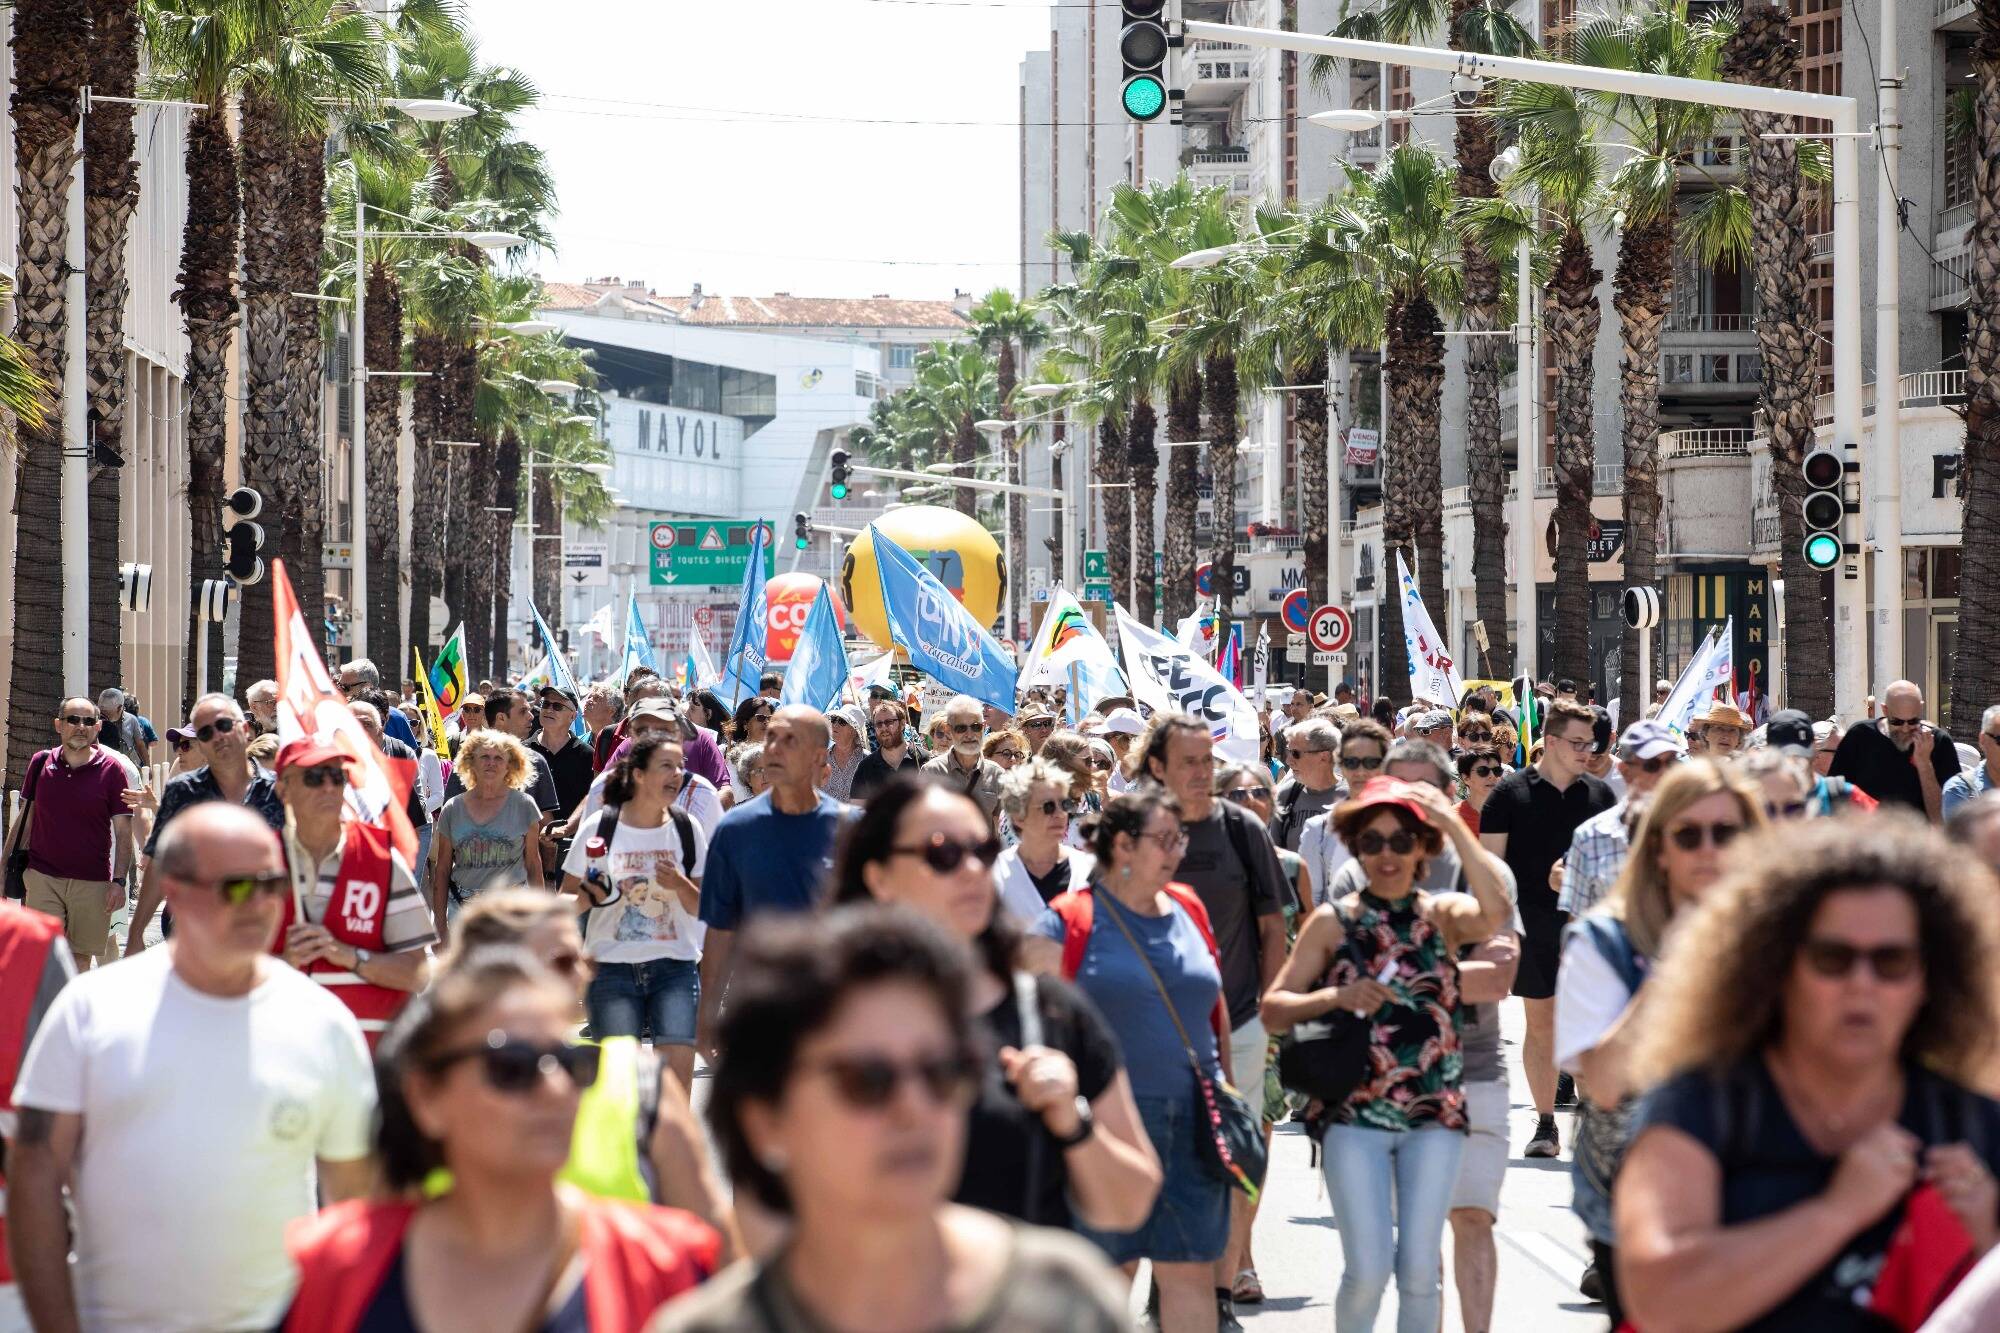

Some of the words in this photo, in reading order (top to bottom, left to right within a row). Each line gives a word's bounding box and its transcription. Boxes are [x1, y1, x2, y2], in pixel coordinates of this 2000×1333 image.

[638, 408, 720, 460] MAYOL
[1352, 432, 1378, 442] VENDU
[677, 555, 710, 565] TOUTES
[715, 555, 769, 565] DIRECTS
[768, 603, 814, 635] cg
[1319, 620, 1341, 638] 30
[1314, 655, 1345, 663] RAPPEL
[1167, 684, 1227, 722] GC
[340, 879, 381, 920] FO
[345, 917, 375, 934] VAR
